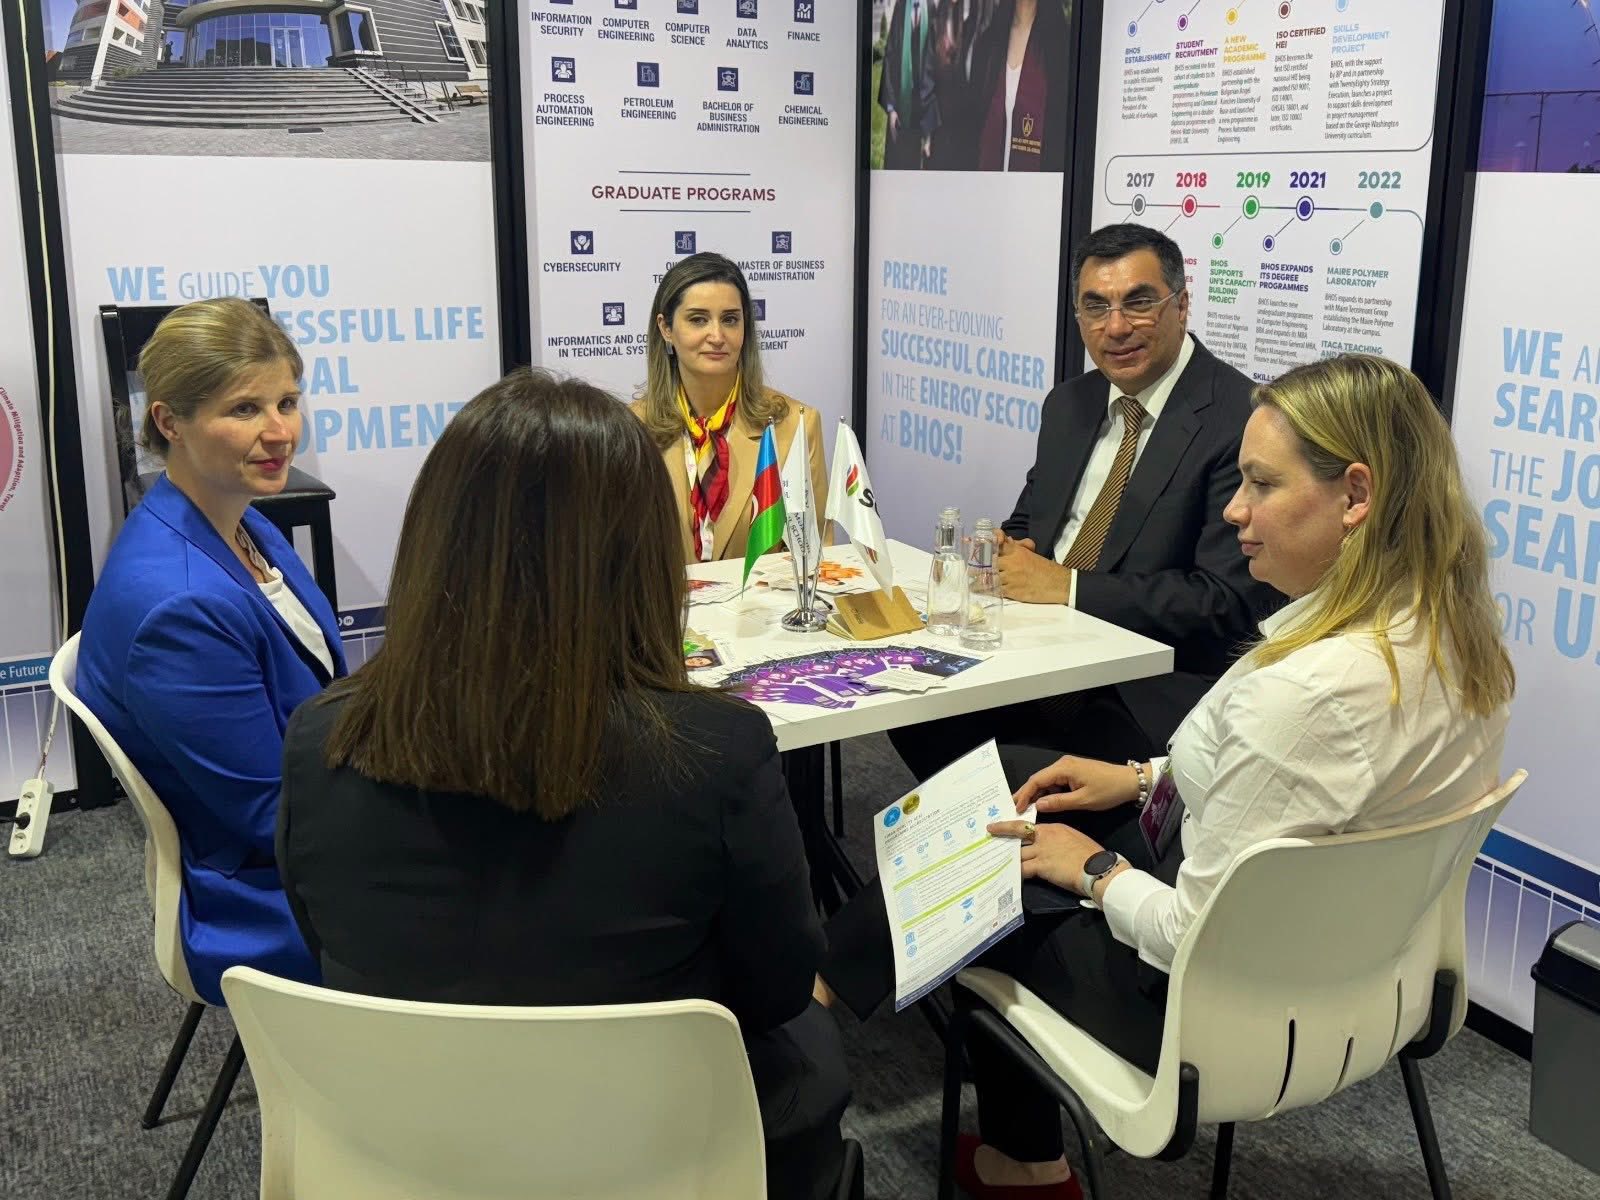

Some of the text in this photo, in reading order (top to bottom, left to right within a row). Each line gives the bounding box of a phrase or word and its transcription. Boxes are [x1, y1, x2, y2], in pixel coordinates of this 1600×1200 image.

[532, 12, 592, 25] INFORMATION
[603, 18, 649, 30] COMPUTER
[541, 25, 584, 36] SECURITY
[665, 23, 710, 34] COMPUTER
[737, 28, 757, 37] DATA
[1277, 27, 1326, 39] ISO CERTIFIED
[1334, 24, 1359, 33] SKILLS
[598, 30, 655, 42] ENGINEERING
[671, 35, 705, 45] SCIENCE
[788, 31, 821, 42] FINANCE
[1333, 31, 1390, 44] DEVELOPMENT
[726, 39, 768, 49] ANALYTICS
[1176, 40, 1204, 49] STUDENT
[1332, 44, 1365, 54] PROJECT
[1125, 47, 1140, 55] BHOS
[1176, 48, 1218, 58] RECRUITMENT
[1125, 53, 1171, 63] ESTABLISHMENT
[1365, 58, 1382, 67] support
[1358, 68, 1384, 77] partnership
[544, 93, 584, 104] PROCESS
[624, 97, 674, 108] PETROLEUM
[536, 105, 593, 115] AUTOMATION
[703, 101, 754, 111] BACHELOR OF
[785, 105, 822, 115] CHEMICAL
[621, 109, 676, 120] ENGINEERING
[710, 112, 747, 122] BUSINESS
[536, 116, 594, 127] ENGINEERING
[779, 116, 828, 126] ENGINEERING
[697, 123, 760, 133] ADMINISTRATION
[1126, 171, 1401, 189] 2017 2018 2019 2021 2022
[591, 185, 776, 202] GRADUATE PROGRAMS
[543, 262, 621, 273] CYBERSECURITY
[738, 261, 825, 270] MASTER OF BUSINESS
[1260, 263, 1313, 273] BHOS EXPANDS
[748, 272, 815, 281] ADMINISTRATION
[883, 260, 948, 296] PREPARE
[1210, 269, 1243, 277] SUPPORTS
[1259, 272, 1299, 282] ITS DEGREE
[1327, 267, 1389, 279] MAIRE POLYMER
[106, 264, 330, 301] WE GUIDE YOU
[1225, 279, 1257, 287] CAPACITY
[1259, 282, 1309, 292] PROGRAMMES
[1327, 278, 1377, 288] LABORATORY
[1209, 286, 1238, 295] BUILDING
[1208, 295, 1236, 304] PROJECT
[414, 306, 484, 340] LIFE
[881, 298, 1004, 341] FOR AN EVER-EVOLVING
[548, 336, 611, 346] INFORMATICS
[615, 335, 633, 344] AND
[761, 341, 788, 350] EMENT
[559, 346, 648, 357] IN TECHNICAL SYST
[1321, 340, 1383, 354] ITACA TEACHING
[1503, 327, 1563, 379] WE
[881, 328, 1045, 390] SUCCESSFUL CAREER
[882, 371, 1040, 433] IN THE ENERGY SECTO
[1493, 382, 1600, 442] SEAR
[881, 410, 963, 465] AT BHOS!
[1490, 449, 1600, 510] THE JO
[1495, 587, 1600, 666] OR U
[9, 665, 46, 679] Future
